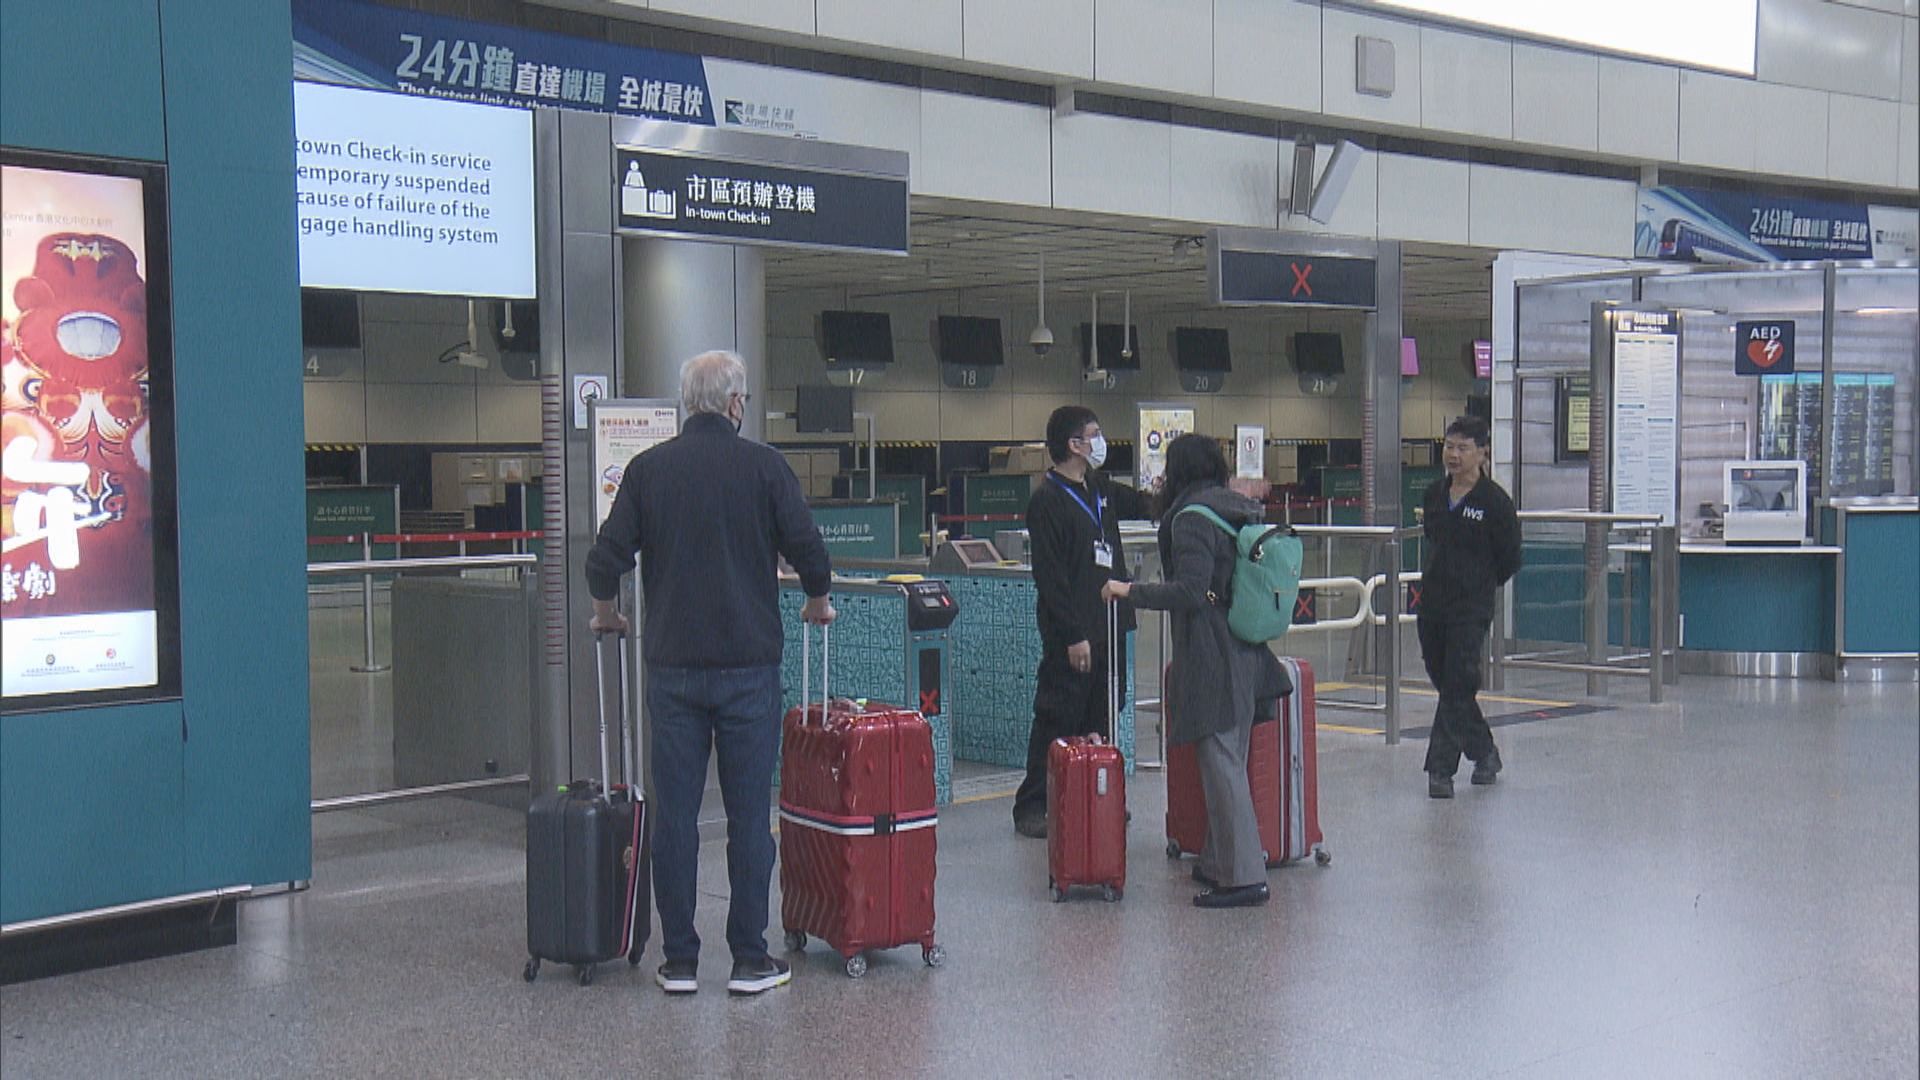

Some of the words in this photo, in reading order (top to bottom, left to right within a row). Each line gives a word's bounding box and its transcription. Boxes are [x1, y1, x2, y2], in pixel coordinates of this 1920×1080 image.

[396, 33, 605, 105] 24分鐘直達機場
[618, 75, 703, 117] 全城最快
[347, 141, 426, 165] Check-in
[431, 153, 492, 171] service
[395, 174, 491, 196] suspended
[686, 174, 816, 213] 市區預辦登機
[354, 192, 373, 210] of
[378, 194, 436, 215] failure
[440, 200, 459, 216] of
[462, 201, 490, 219] the
[686, 205, 726, 220] In-town
[727, 210, 771, 225] Check-in
[301, 217, 348, 236] gage
[352, 216, 434, 243] handling
[438, 226, 499, 245] system
[1750, 326, 1781, 341] AED
[849, 368, 864, 384] 17
[961, 369, 976, 386] 18
[1194, 375, 1209, 391] 20
[1312, 378, 1324, 393] 21
[1462, 505, 1485, 522] IWS
